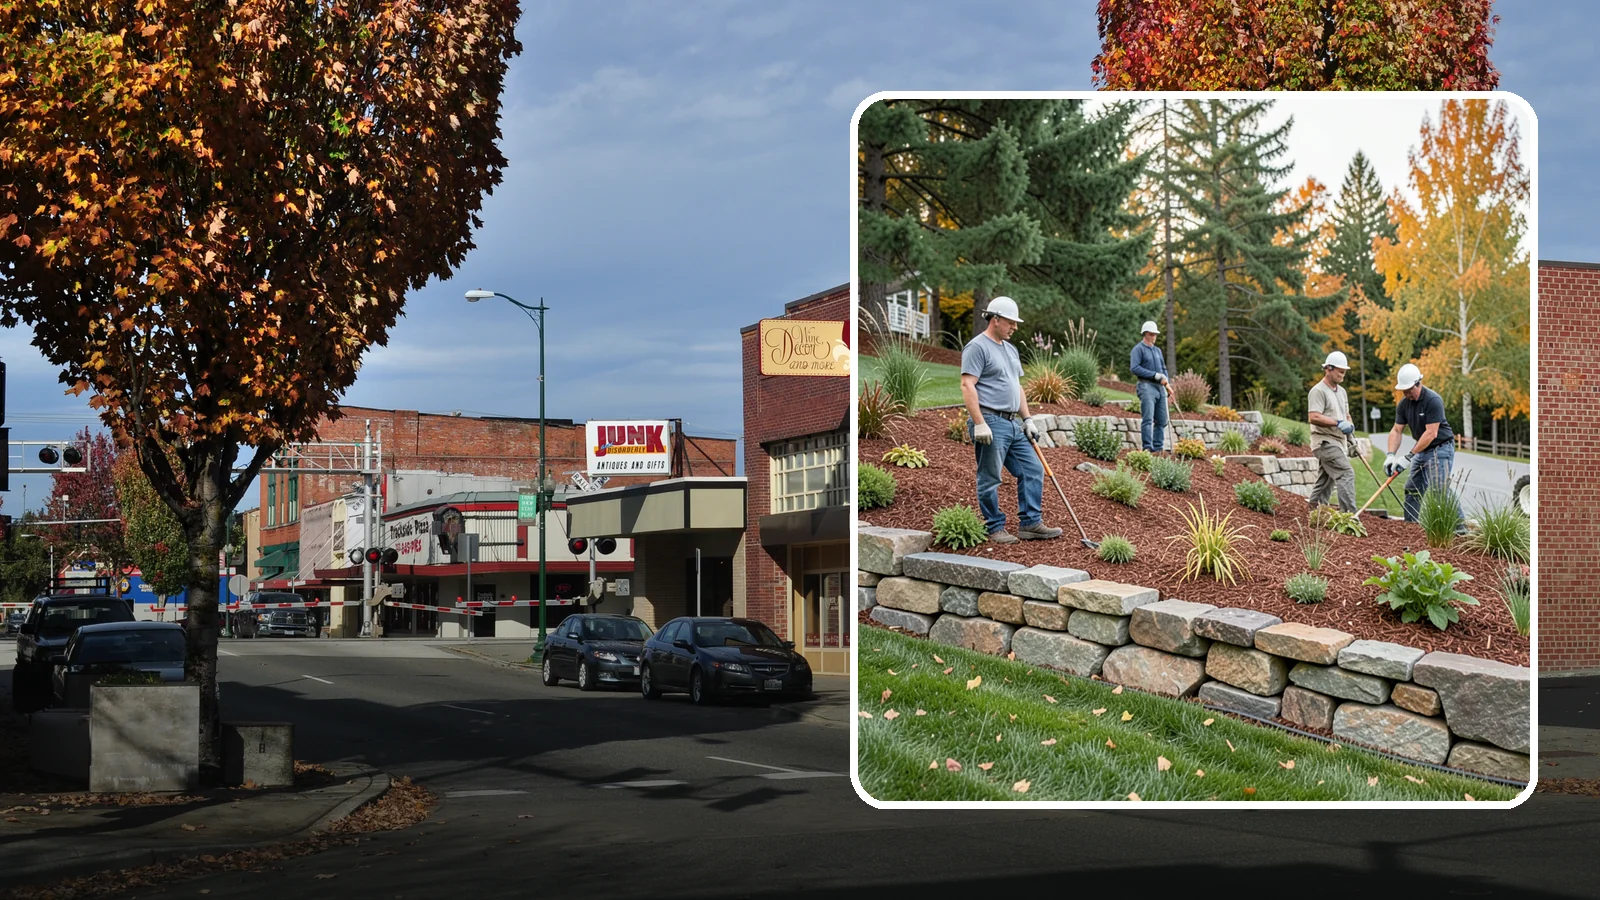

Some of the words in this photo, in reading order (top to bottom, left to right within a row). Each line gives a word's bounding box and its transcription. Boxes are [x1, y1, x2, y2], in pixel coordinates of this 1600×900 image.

[595, 425, 665, 457] JUNK
[597, 461, 628, 470] ANTIQUES
[631, 461, 644, 470] AND
[646, 460, 665, 470] GIFTS
[414, 519, 429, 535] Pizza
